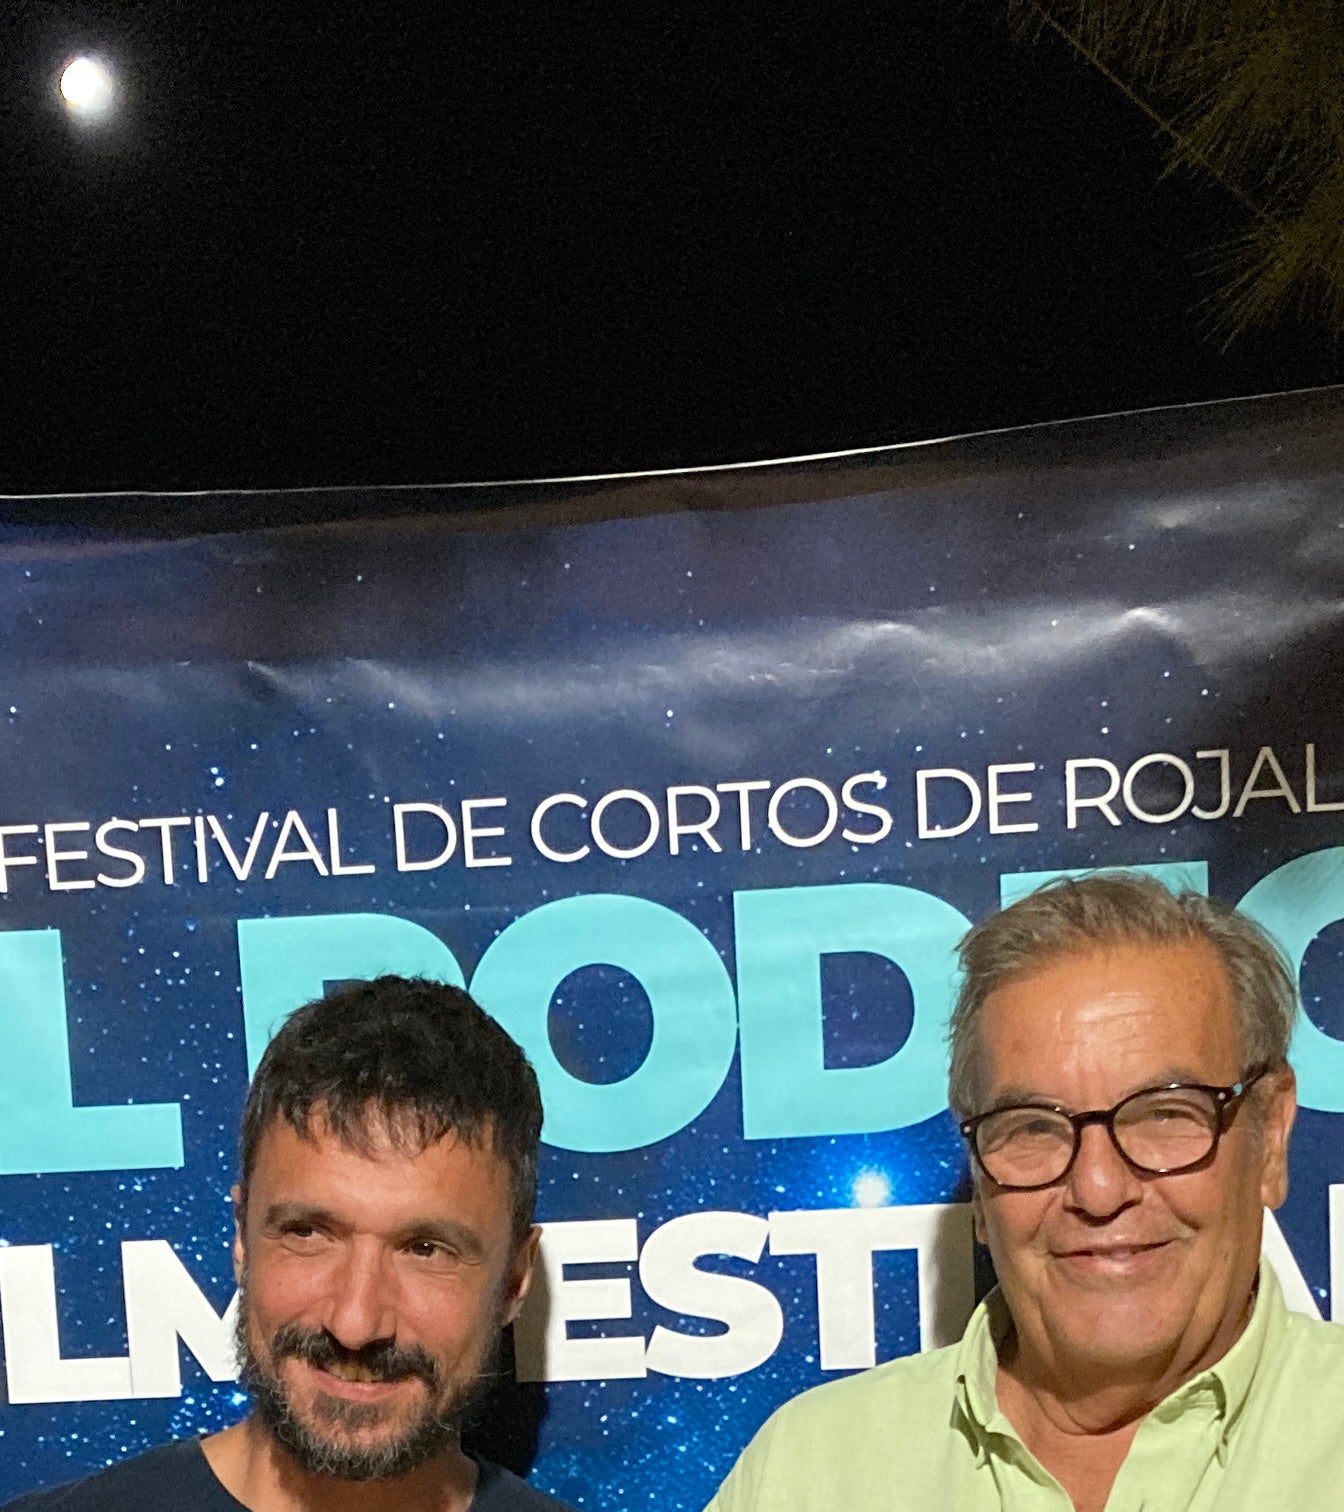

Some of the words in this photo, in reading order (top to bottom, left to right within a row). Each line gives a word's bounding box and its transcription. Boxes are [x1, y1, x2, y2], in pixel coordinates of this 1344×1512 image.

[393, 798, 512, 872] DE
[530, 771, 893, 861] CORTOS
[917, 761, 1039, 839] DE
